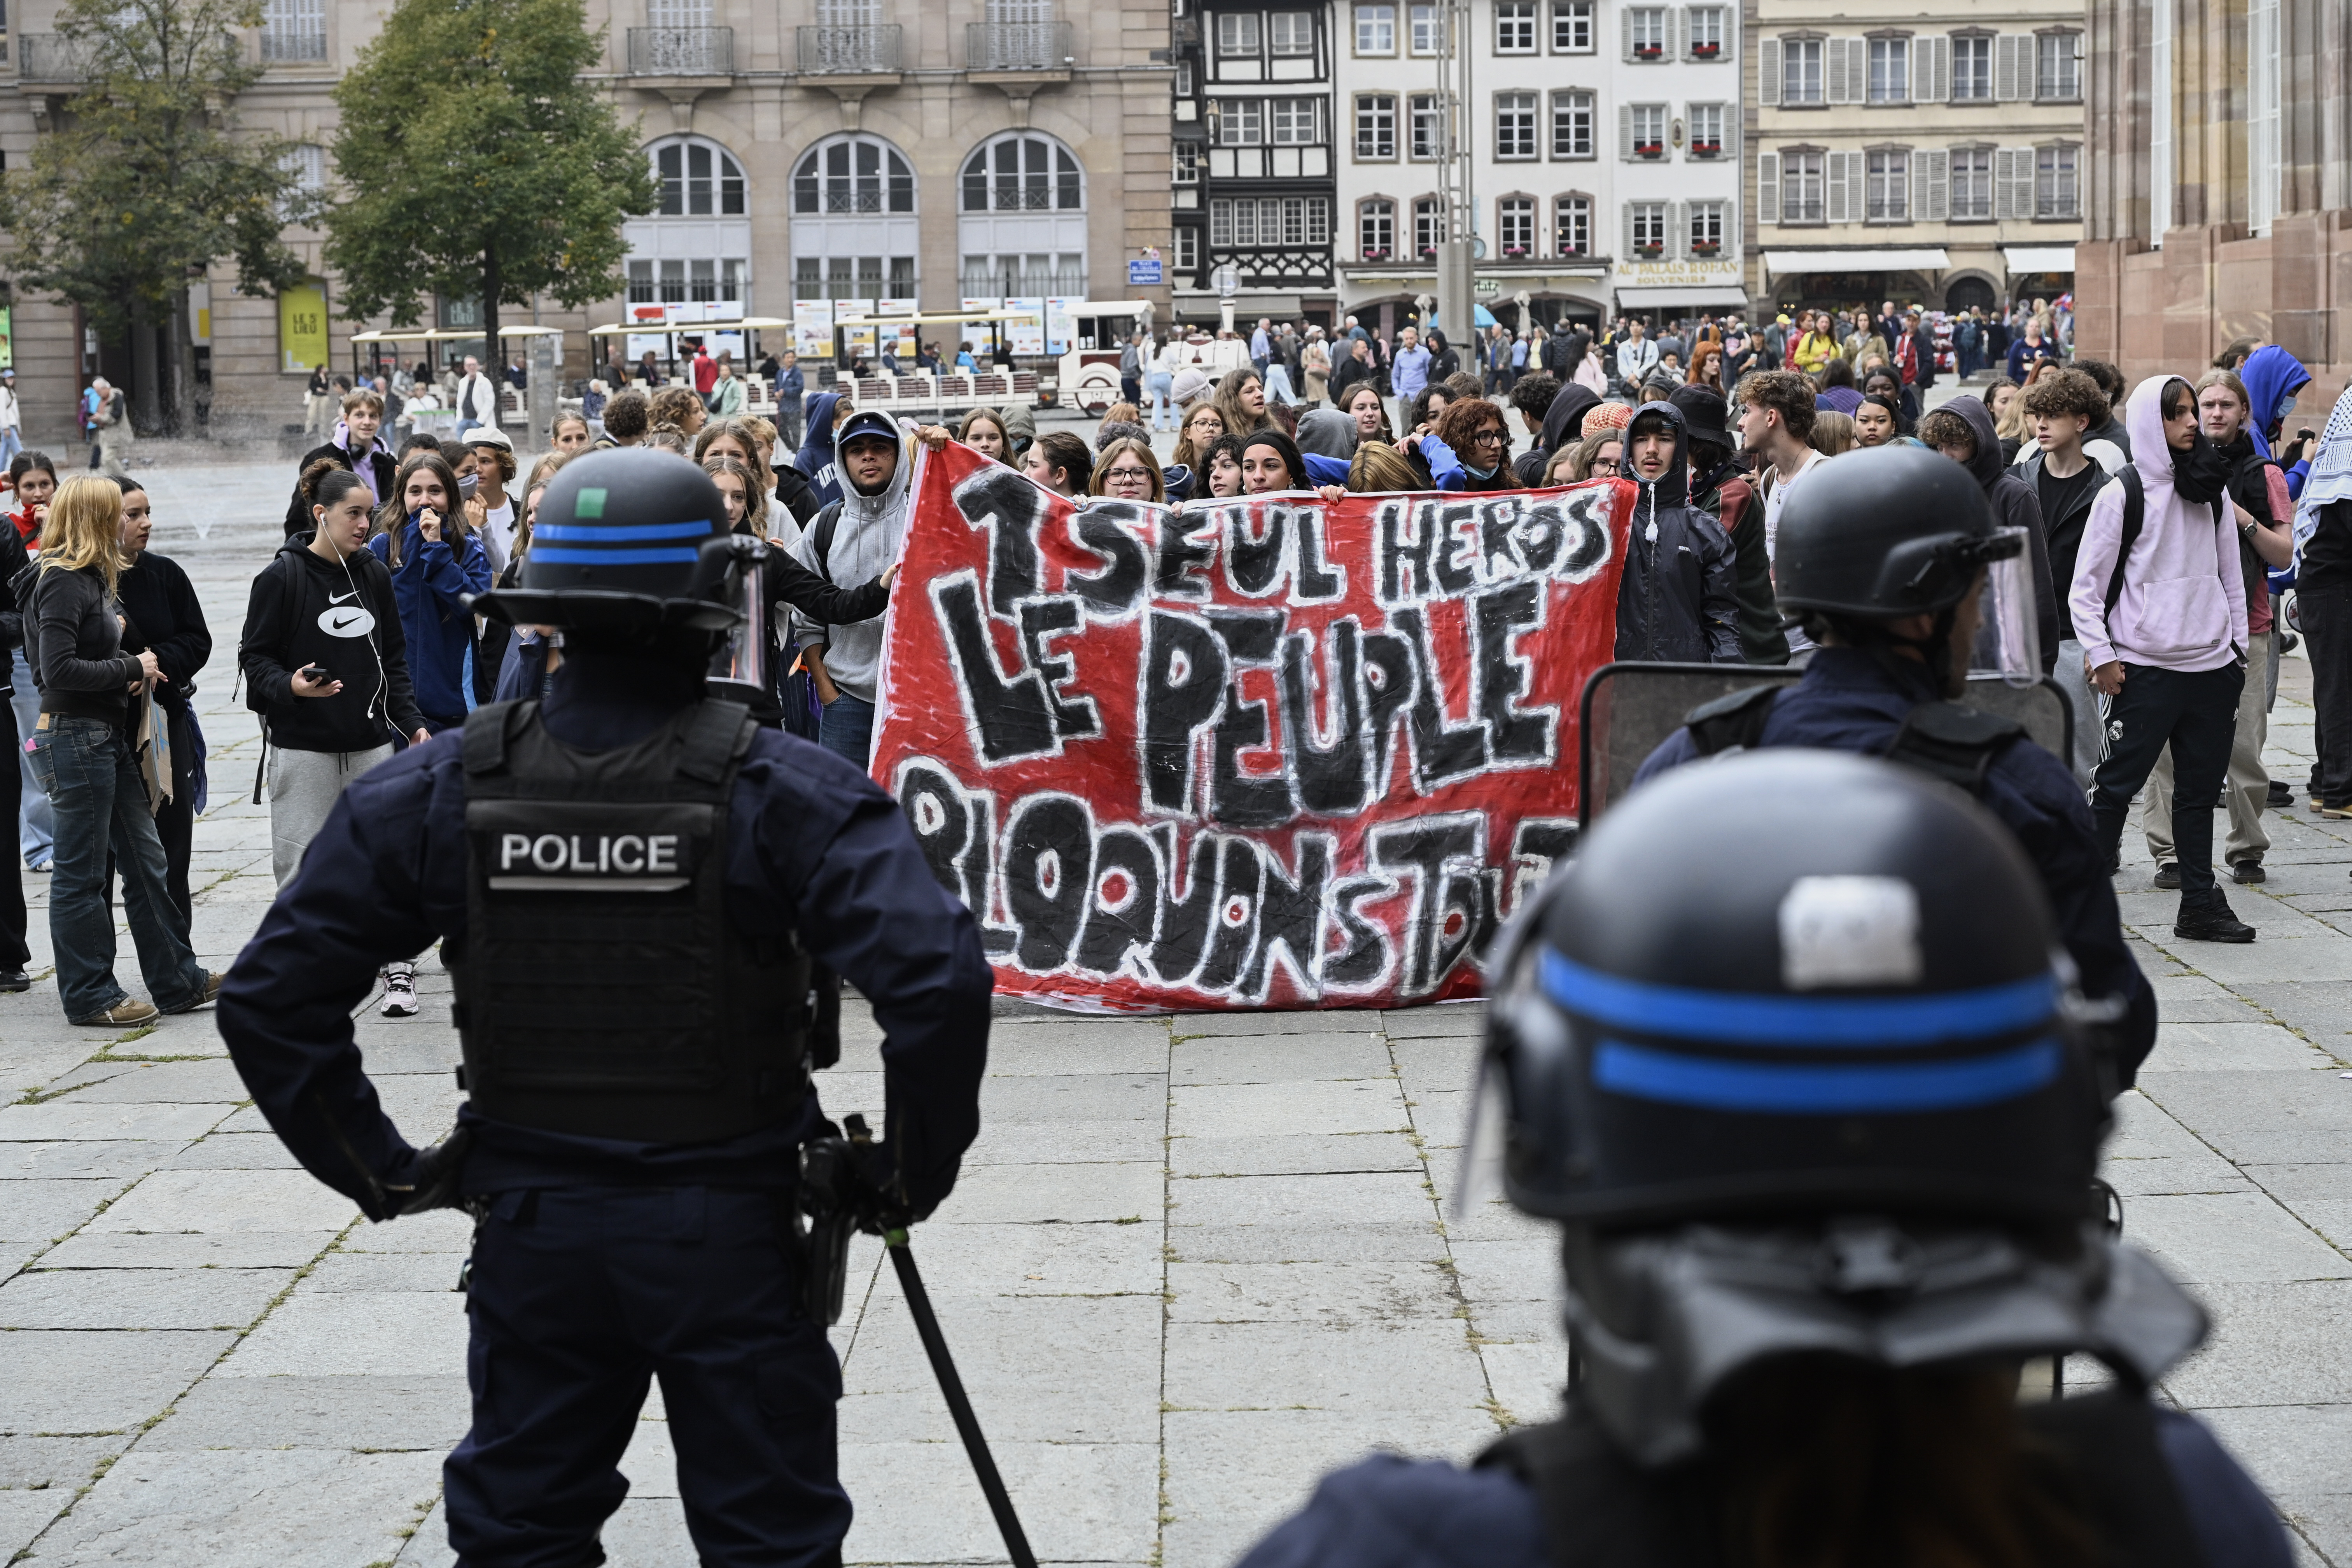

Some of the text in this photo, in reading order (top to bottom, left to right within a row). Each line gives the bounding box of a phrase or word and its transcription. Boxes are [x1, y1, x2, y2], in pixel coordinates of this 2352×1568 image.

[1474, 280, 1499, 291] latz
[1636, 276, 1706, 284] SOUVENIRS
[953, 466, 1612, 623] 1 SEUL HEROS
[931, 567, 1560, 828] LE PEUPLE
[500, 833, 679, 873] POLICE
